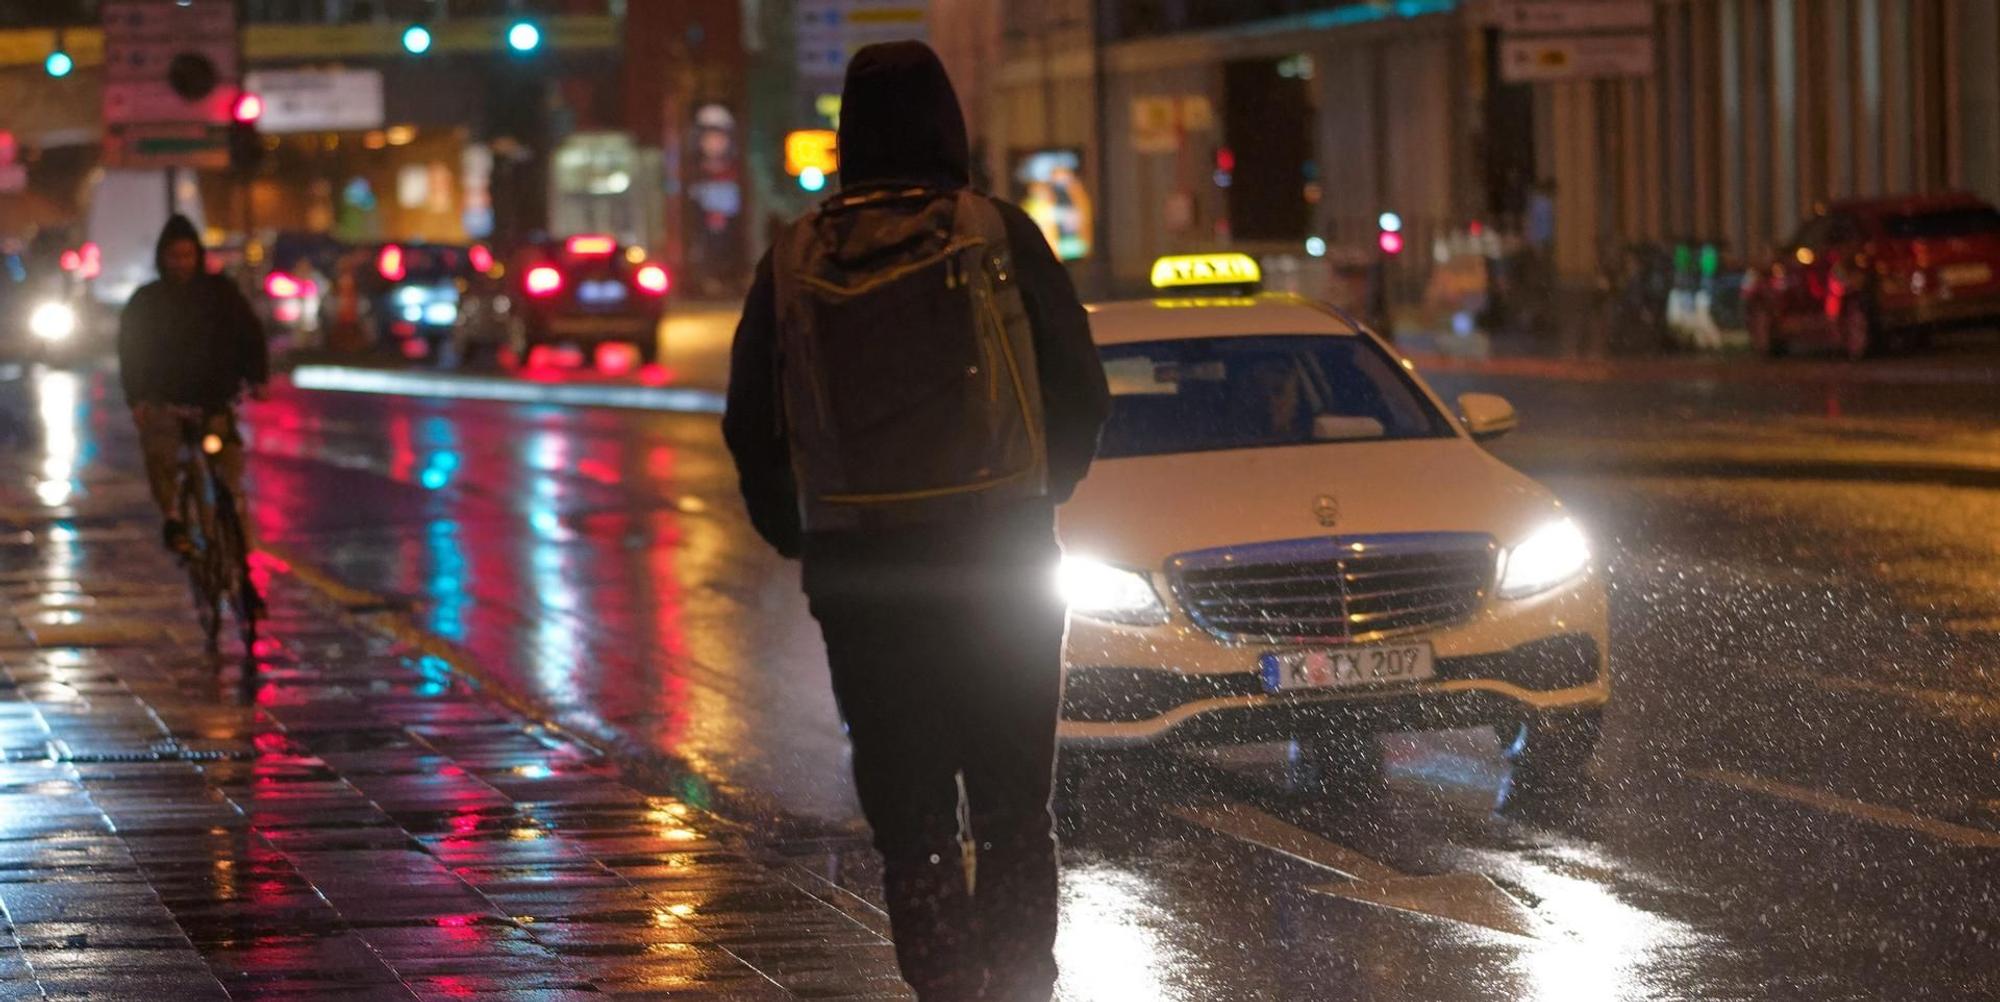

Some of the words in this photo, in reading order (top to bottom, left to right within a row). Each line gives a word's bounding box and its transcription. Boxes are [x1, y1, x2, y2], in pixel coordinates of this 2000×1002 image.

[1289, 654, 1307, 683] K
[1327, 652, 1363, 681] TX
[1371, 648, 1420, 677] 207
